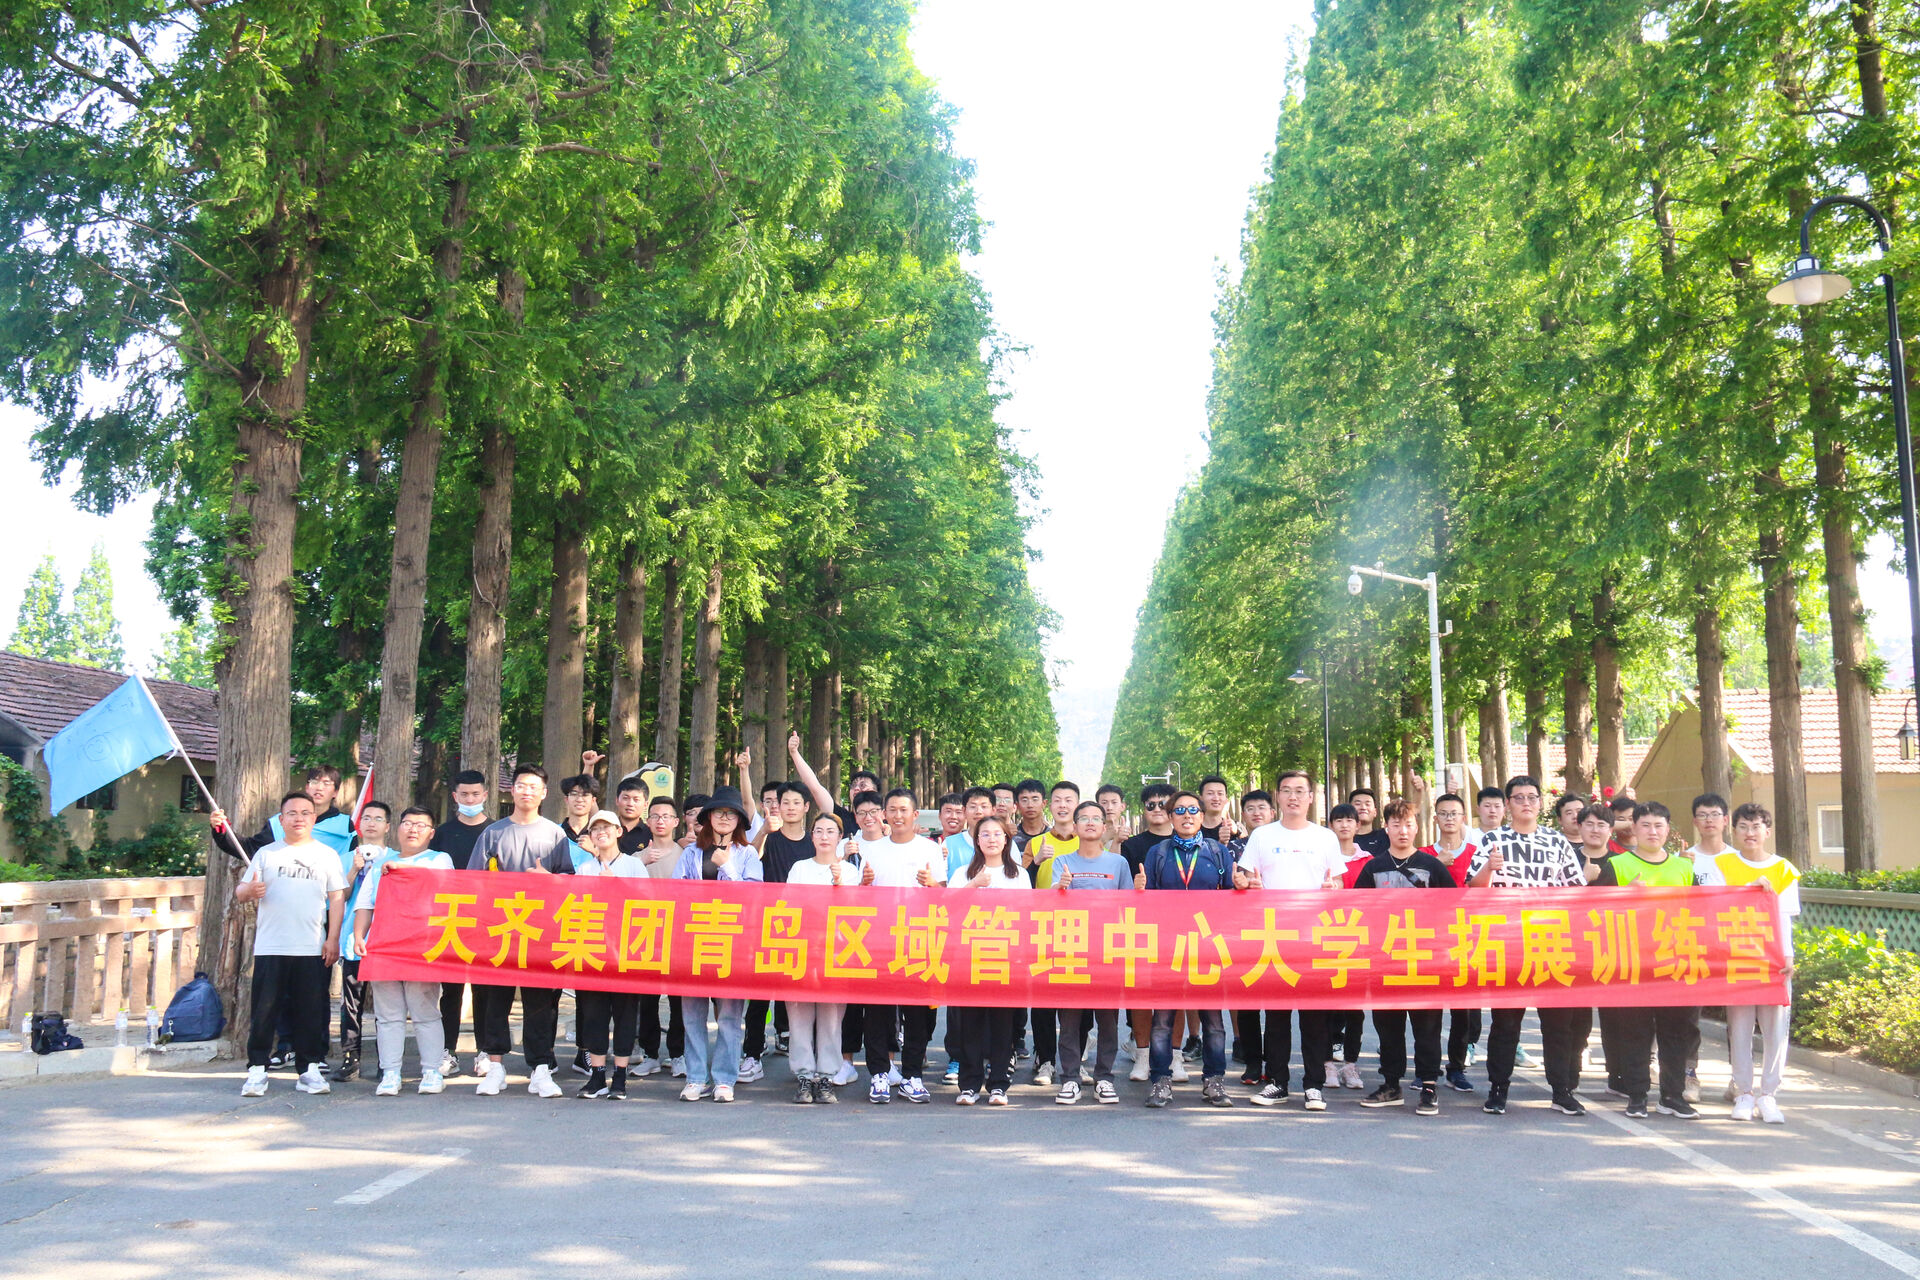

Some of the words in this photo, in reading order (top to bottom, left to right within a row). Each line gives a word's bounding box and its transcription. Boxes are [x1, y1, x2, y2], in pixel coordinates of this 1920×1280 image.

[422, 890, 1774, 989] 天齐集团青岛区域管理中心大学生拓展训练营
